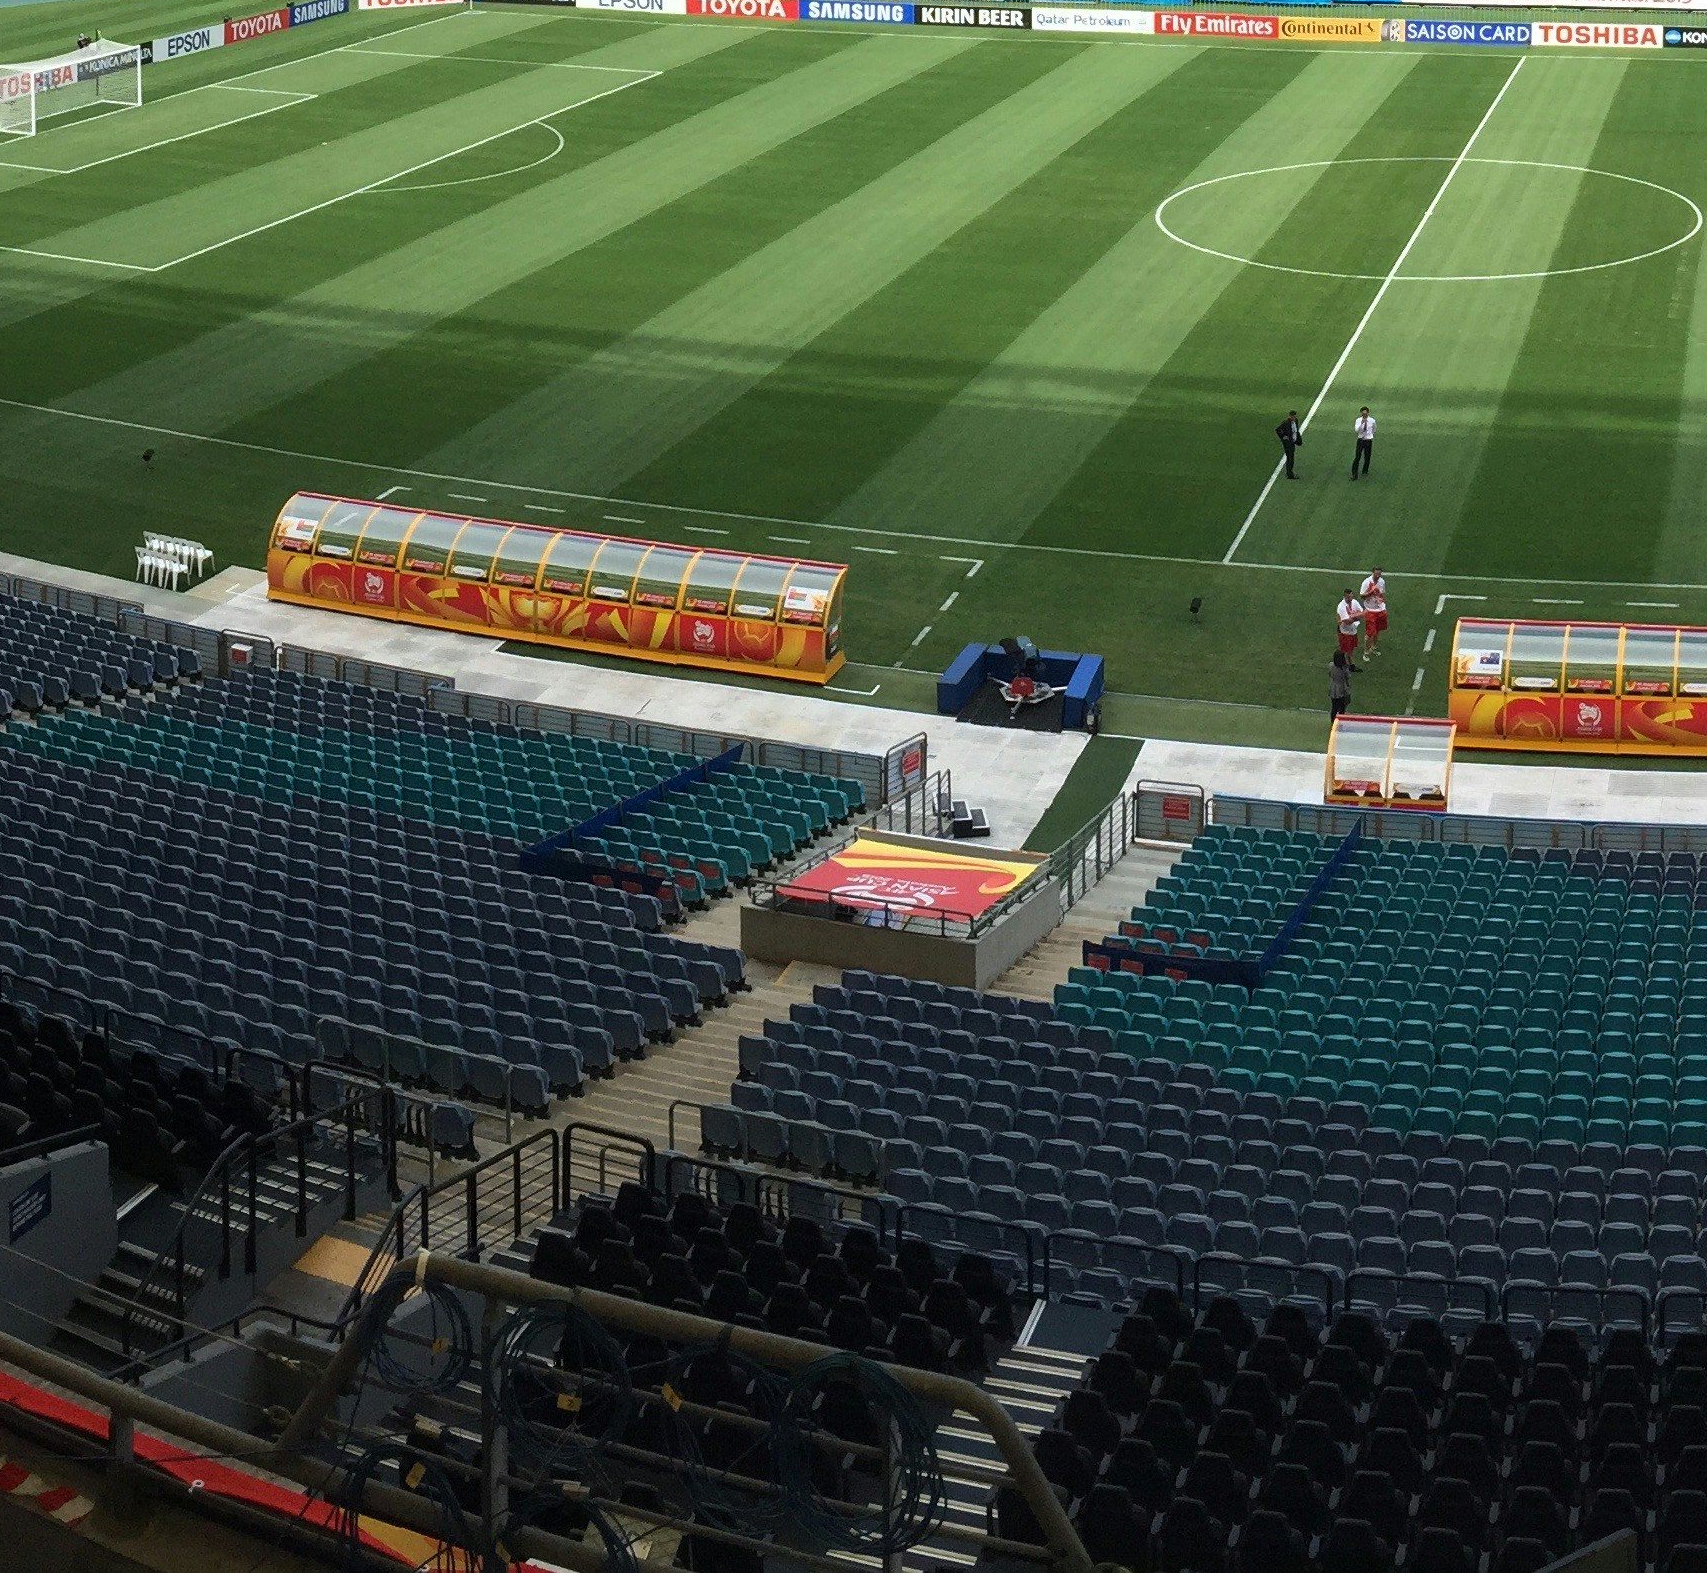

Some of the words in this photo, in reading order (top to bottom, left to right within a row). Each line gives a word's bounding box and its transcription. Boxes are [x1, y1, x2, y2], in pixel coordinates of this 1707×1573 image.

[808, 1, 903, 22] SAMSUNG
[921, 7, 975, 24] KIRIN
[979, 8, 1023, 27] BEER
[1036, 14, 1068, 27] Qatar
[231, 14, 281, 41] TOYOTA
[1161, 14, 1192, 35] Fly
[1196, 15, 1273, 35] Emirates
[1281, 20, 1362, 37] Continental
[1407, 24, 1474, 40] SAISON
[1479, 25, 1530, 41] CARD
[167, 30, 211, 57] EPSON
[1539, 25, 1658, 45] TOSHIBA
